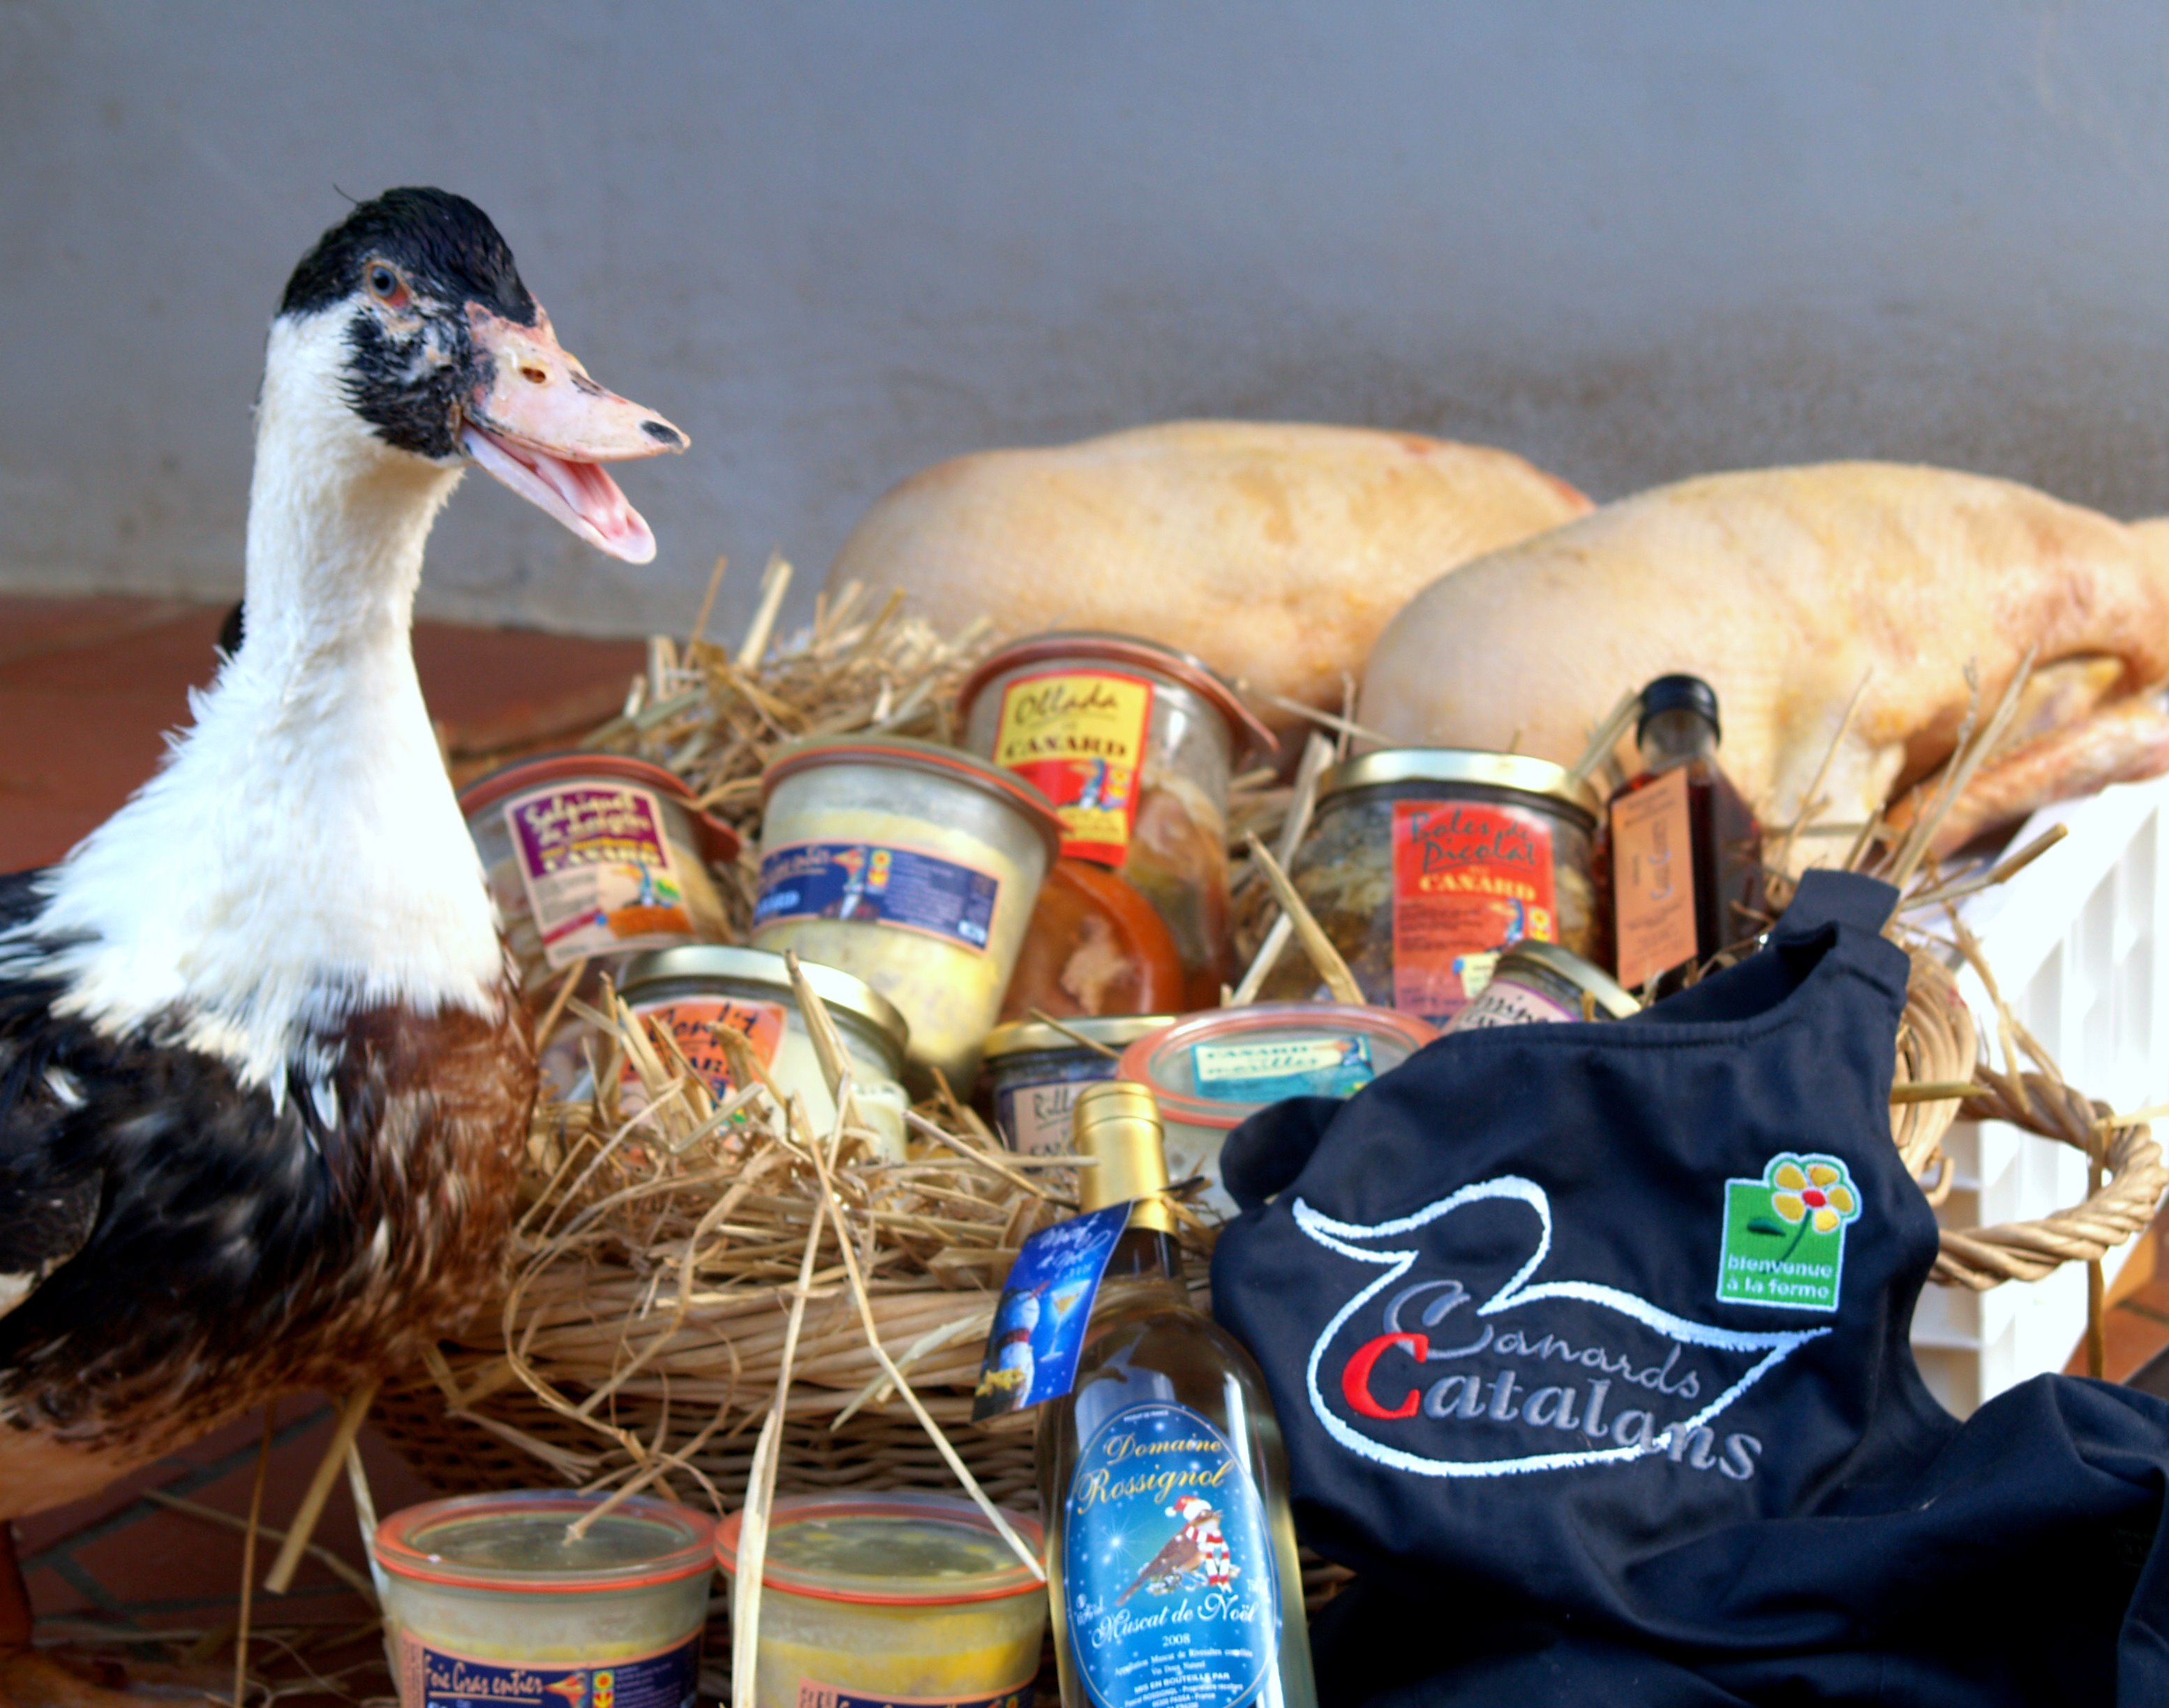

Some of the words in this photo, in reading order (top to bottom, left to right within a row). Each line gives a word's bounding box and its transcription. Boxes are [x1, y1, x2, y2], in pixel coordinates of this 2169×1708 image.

[1015, 682, 1119, 726] Ollada
[1006, 736, 1127, 758] CANARD
[1419, 874, 1537, 901] CANARD
[1727, 1253, 1834, 1278] bienvenue
[1726, 1275, 1738, 1291] à
[1745, 1276, 1764, 1294] la
[1768, 1278, 1830, 1299] ferme
[1382, 1280, 1701, 1399] Canards
[1341, 1332, 1762, 1480] Catalans
[1103, 1432, 1221, 1465] Domaine
[1077, 1458, 1236, 1515] Rossignol
[1091, 1605, 1168, 1648] Muscat
[1171, 1598, 1194, 1624] de
[1197, 1592, 1256, 1623] Noël
[452, 1661, 489, 1695] Gras
[492, 1669, 544, 1696] entier
[1149, 1679, 1163, 1690] EN
[1163, 1675, 1212, 1686] BOUTEILLE
[1212, 1672, 1230, 1681] PAR
